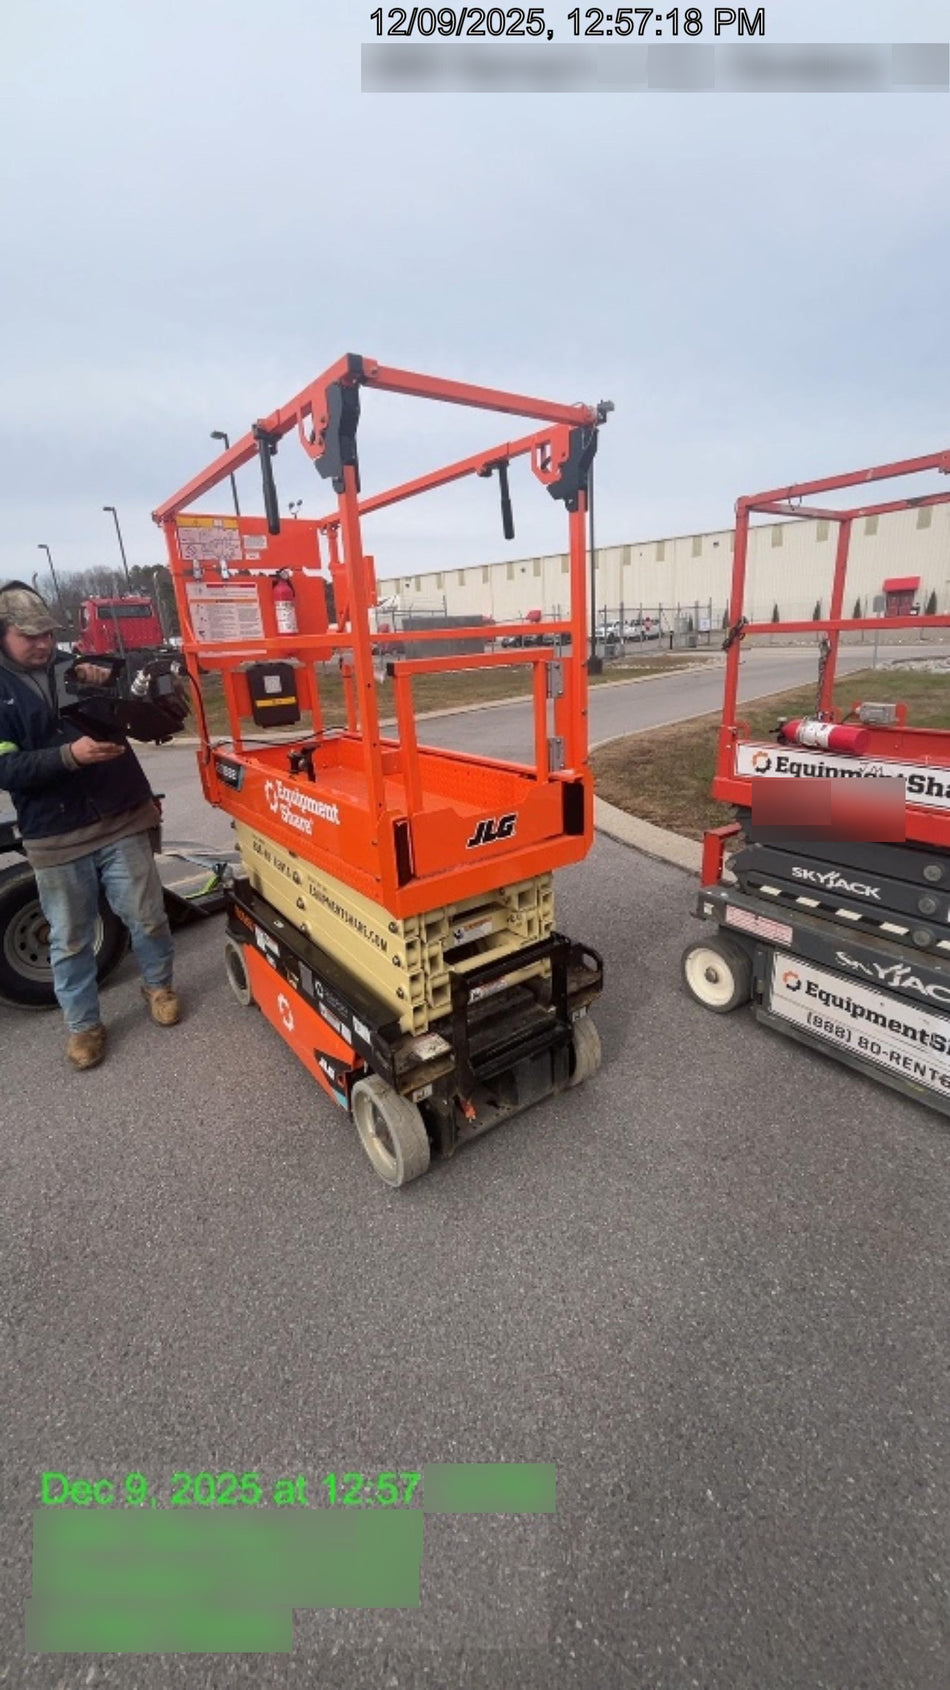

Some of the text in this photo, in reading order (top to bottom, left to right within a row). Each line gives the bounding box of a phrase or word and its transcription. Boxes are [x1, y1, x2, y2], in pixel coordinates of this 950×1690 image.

[275, 779, 340, 825] Equipment
[279, 803, 313, 835] Share
[466, 812, 518, 850] JLG
[791, 866, 882, 900] SKYJACK
[805, 979, 950, 1056] EquipmentS
[806, 1011, 852, 1043] (888)
